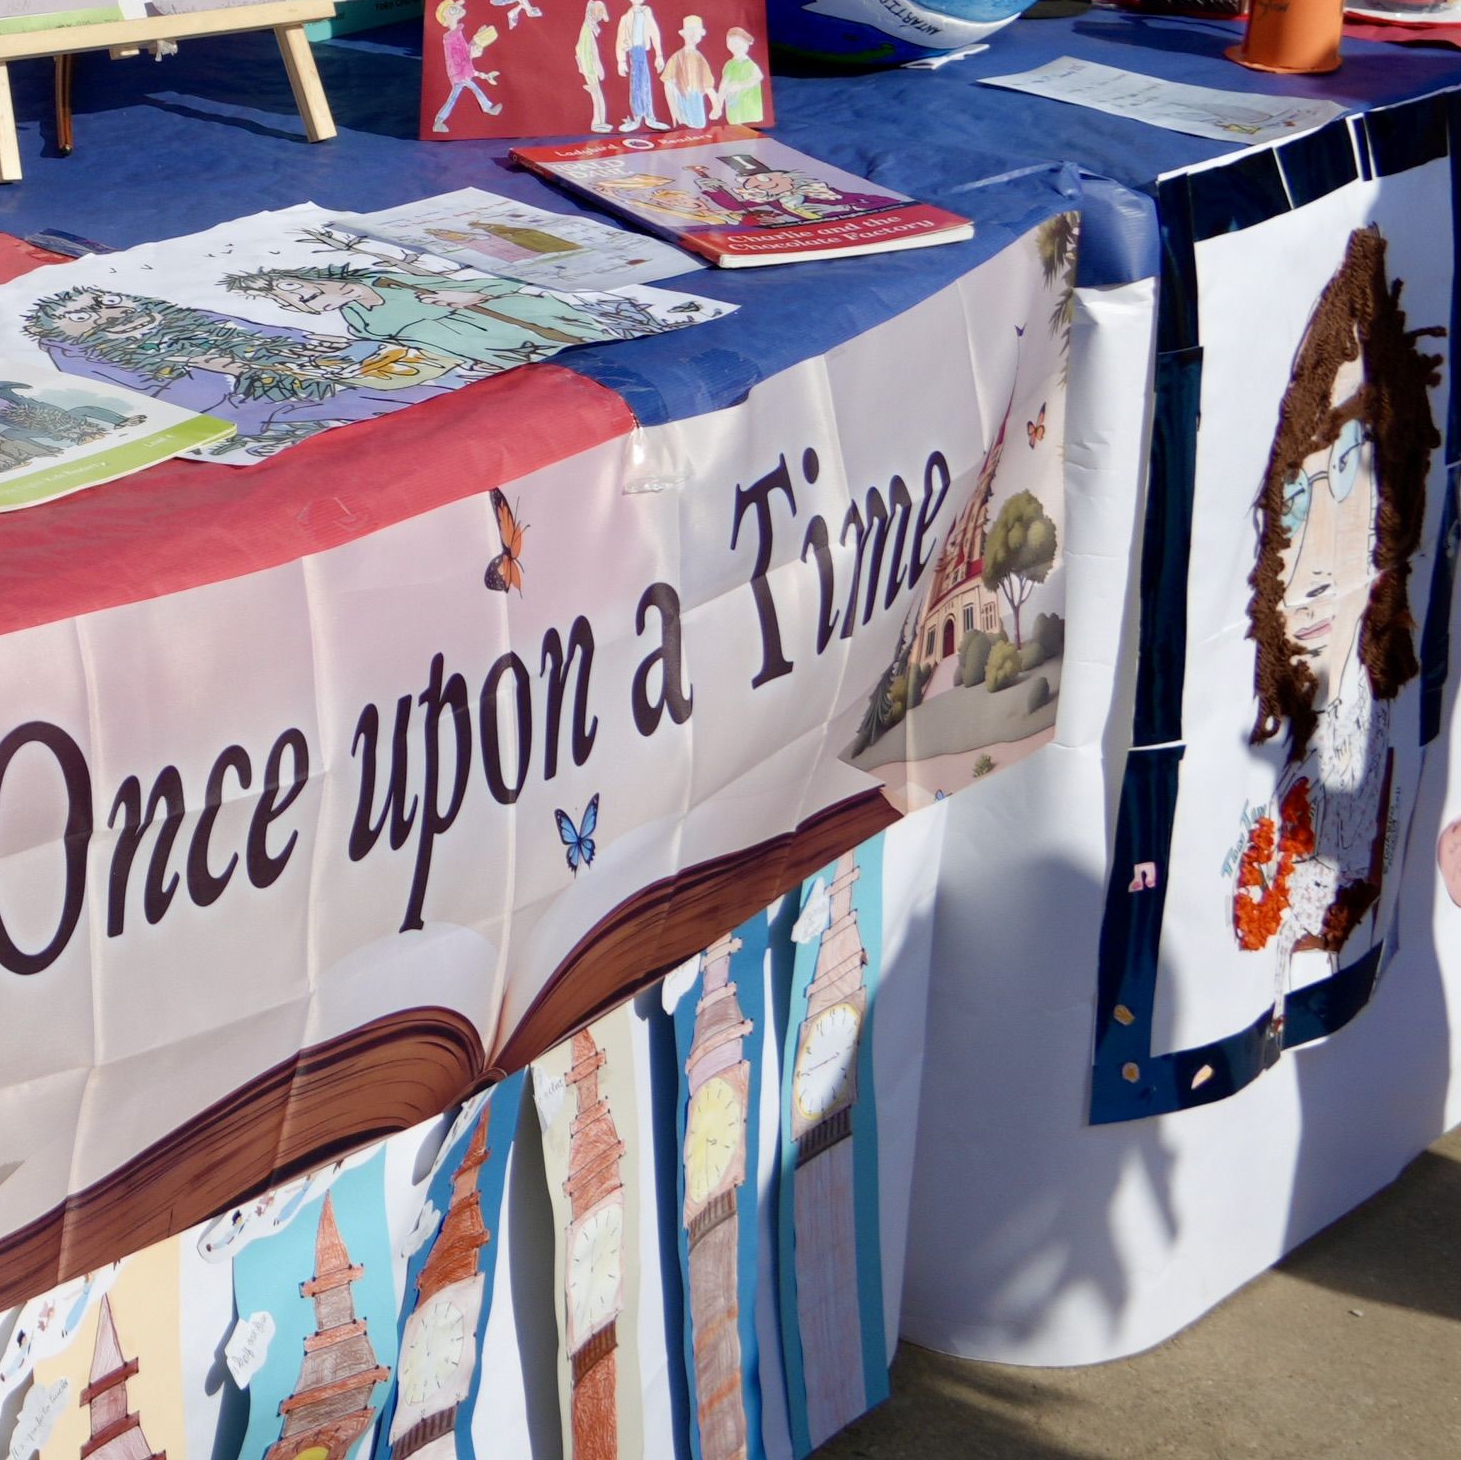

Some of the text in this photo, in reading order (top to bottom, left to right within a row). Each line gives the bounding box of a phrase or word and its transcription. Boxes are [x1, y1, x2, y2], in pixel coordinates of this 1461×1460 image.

[554, 142, 621, 158] Ladybird
[726, 213, 902, 245] Charlie and the
[727, 218, 935, 255] Chocolate Factory
[345, 610, 601, 936] upon
[627, 577, 695, 739] a
[729, 444, 954, 691] Time
